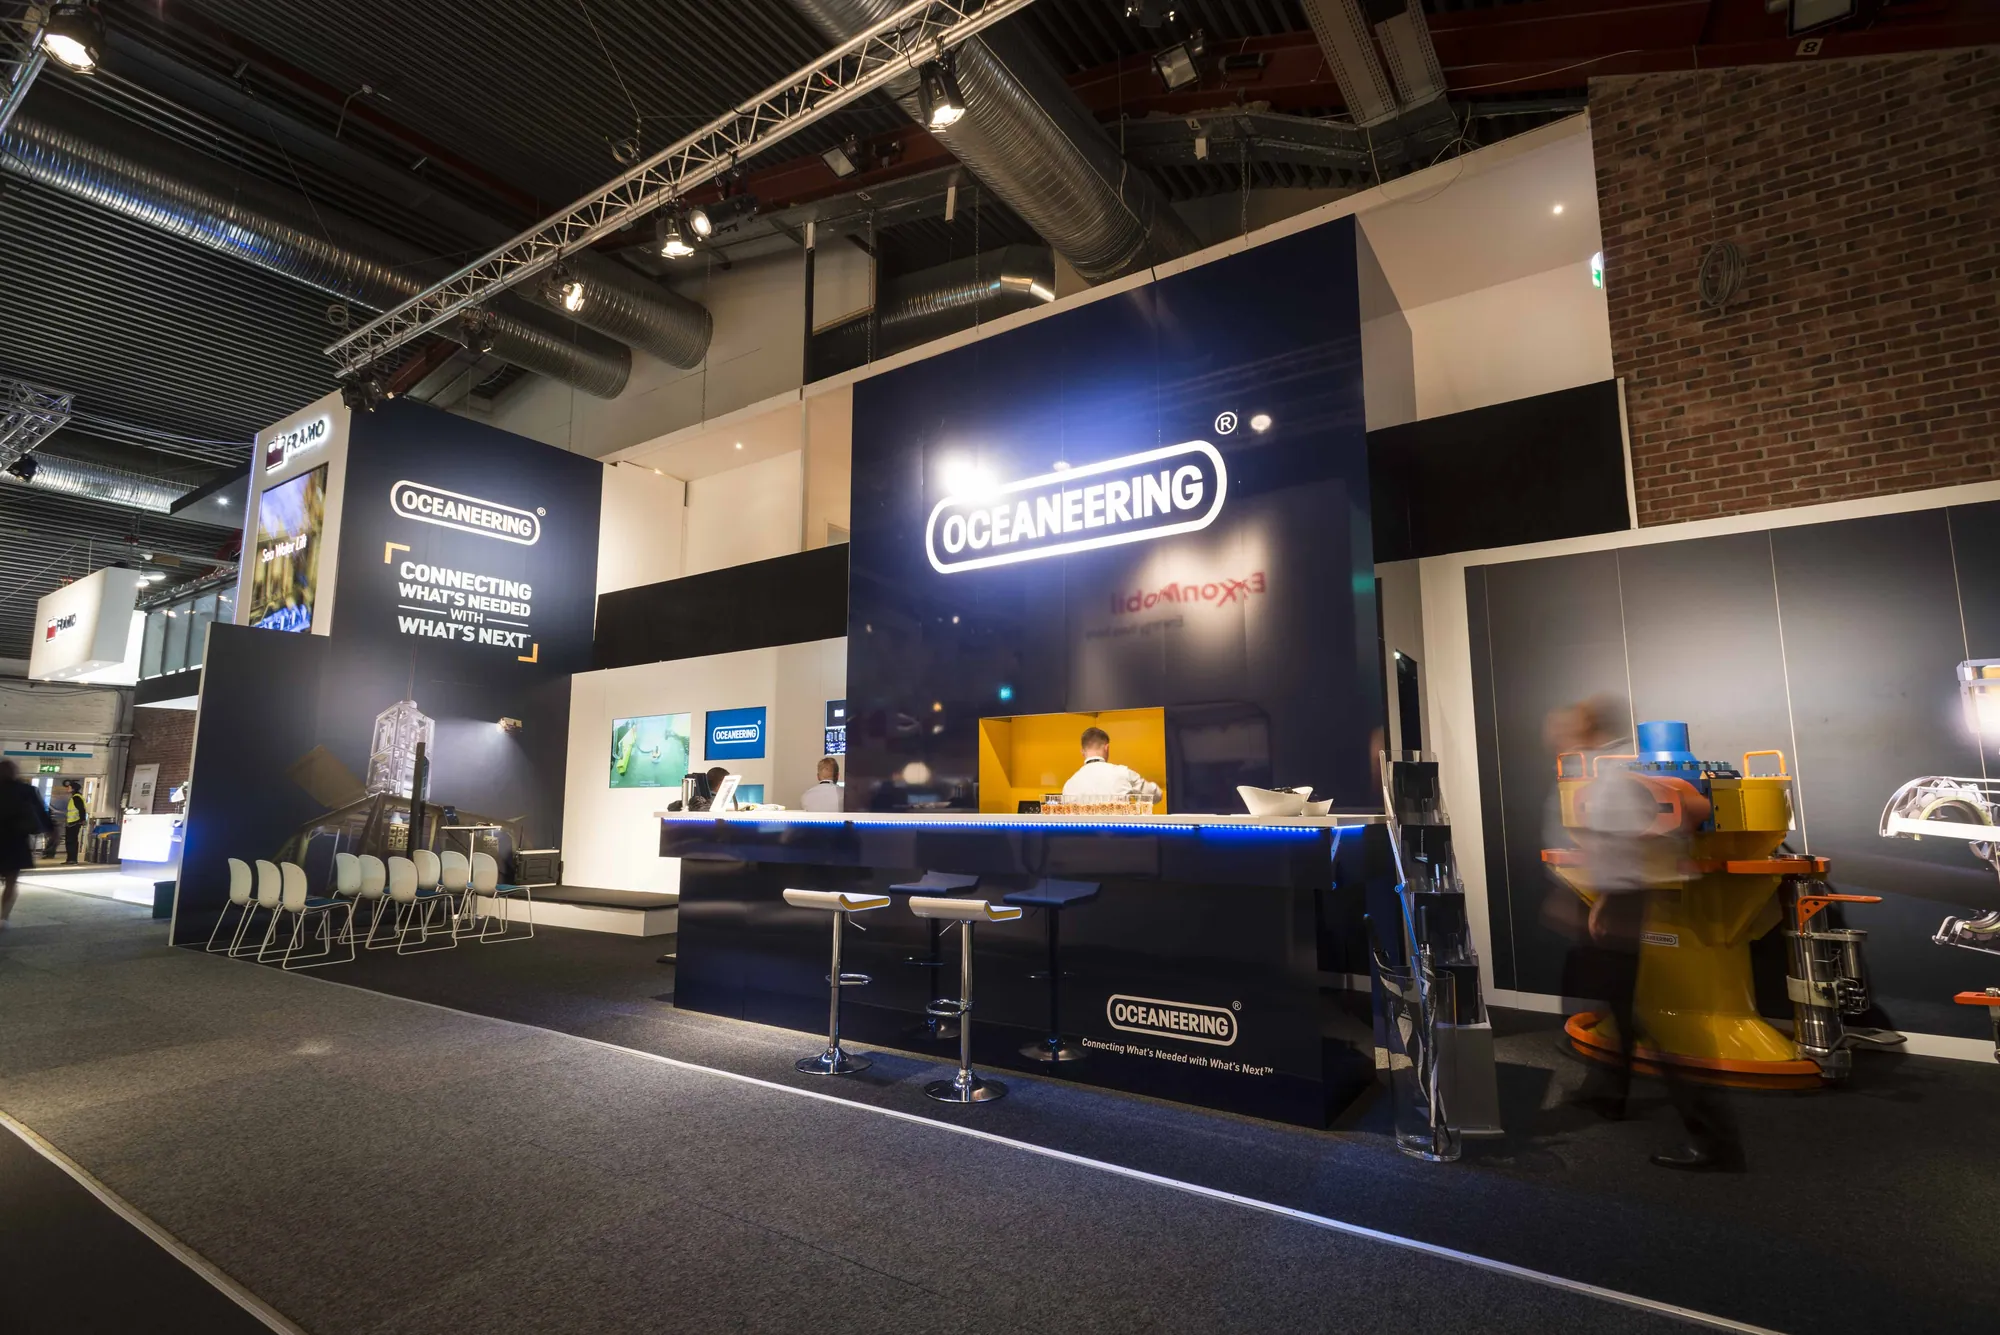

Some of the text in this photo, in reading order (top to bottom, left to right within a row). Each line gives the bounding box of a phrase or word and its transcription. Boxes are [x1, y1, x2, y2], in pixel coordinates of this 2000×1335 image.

[286, 419, 325, 453] FRAMO
[401, 490, 532, 537] OCEANEERING
[943, 464, 1204, 554] OCEANEERING
[262, 548, 274, 562] Sea
[295, 533, 307, 551] Lift
[400, 561, 532, 600] CONNECTING
[398, 581, 531, 617] WHAT'S NEEDED
[398, 615, 475, 642] WHAT'S
[450, 608, 483, 624] WITH
[36, 741, 77, 752] Hall 4
[716, 728, 757, 740] OCEANEERING
[1115, 1003, 1229, 1036] OCEANEERING
[1082, 1037, 1125, 1054] Connecting
[1126, 1044, 1154, 1058] What's
[1155, 1049, 1188, 1064] Needed
[1189, 1055, 1208, 1067] with
[1210, 1058, 1240, 1073] What's
